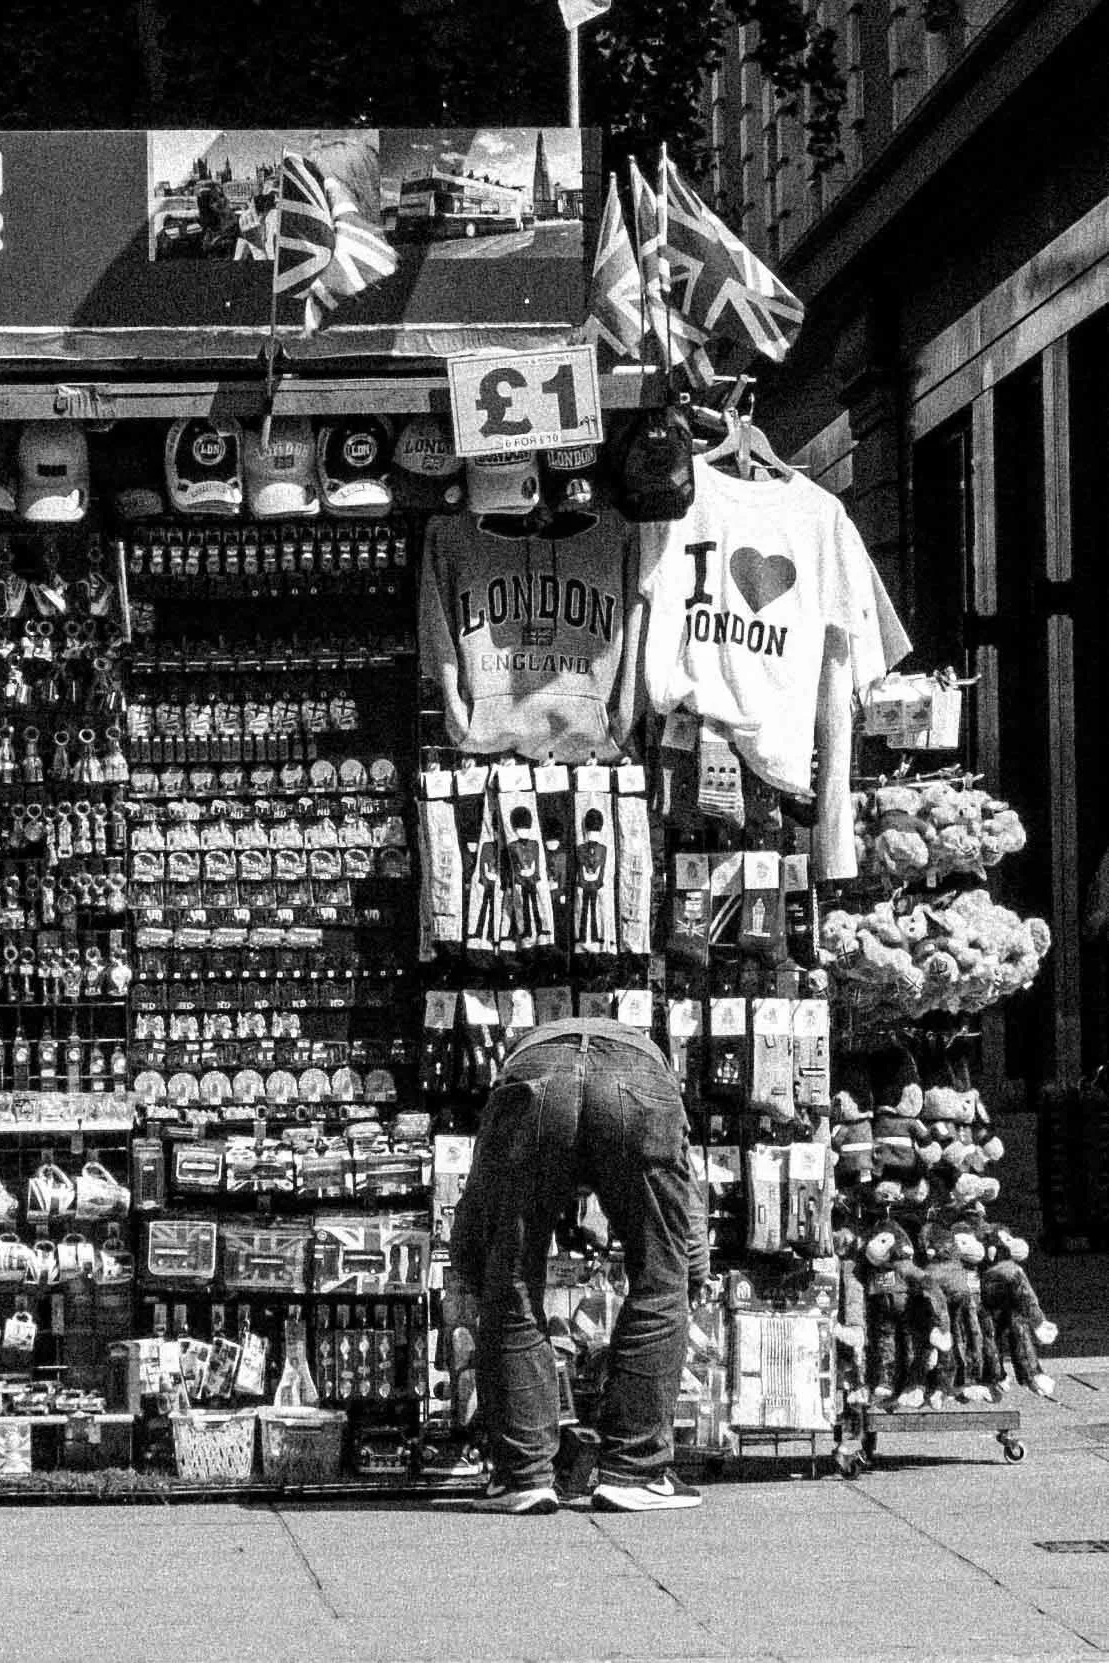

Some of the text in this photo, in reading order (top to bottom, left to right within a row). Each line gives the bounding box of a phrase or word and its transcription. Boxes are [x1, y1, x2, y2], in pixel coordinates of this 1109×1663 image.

[514, 437, 536, 447] FOR
[684, 541, 717, 610] I
[459, 575, 616, 642] LONDON
[481, 653, 592, 675] ENGLAND
